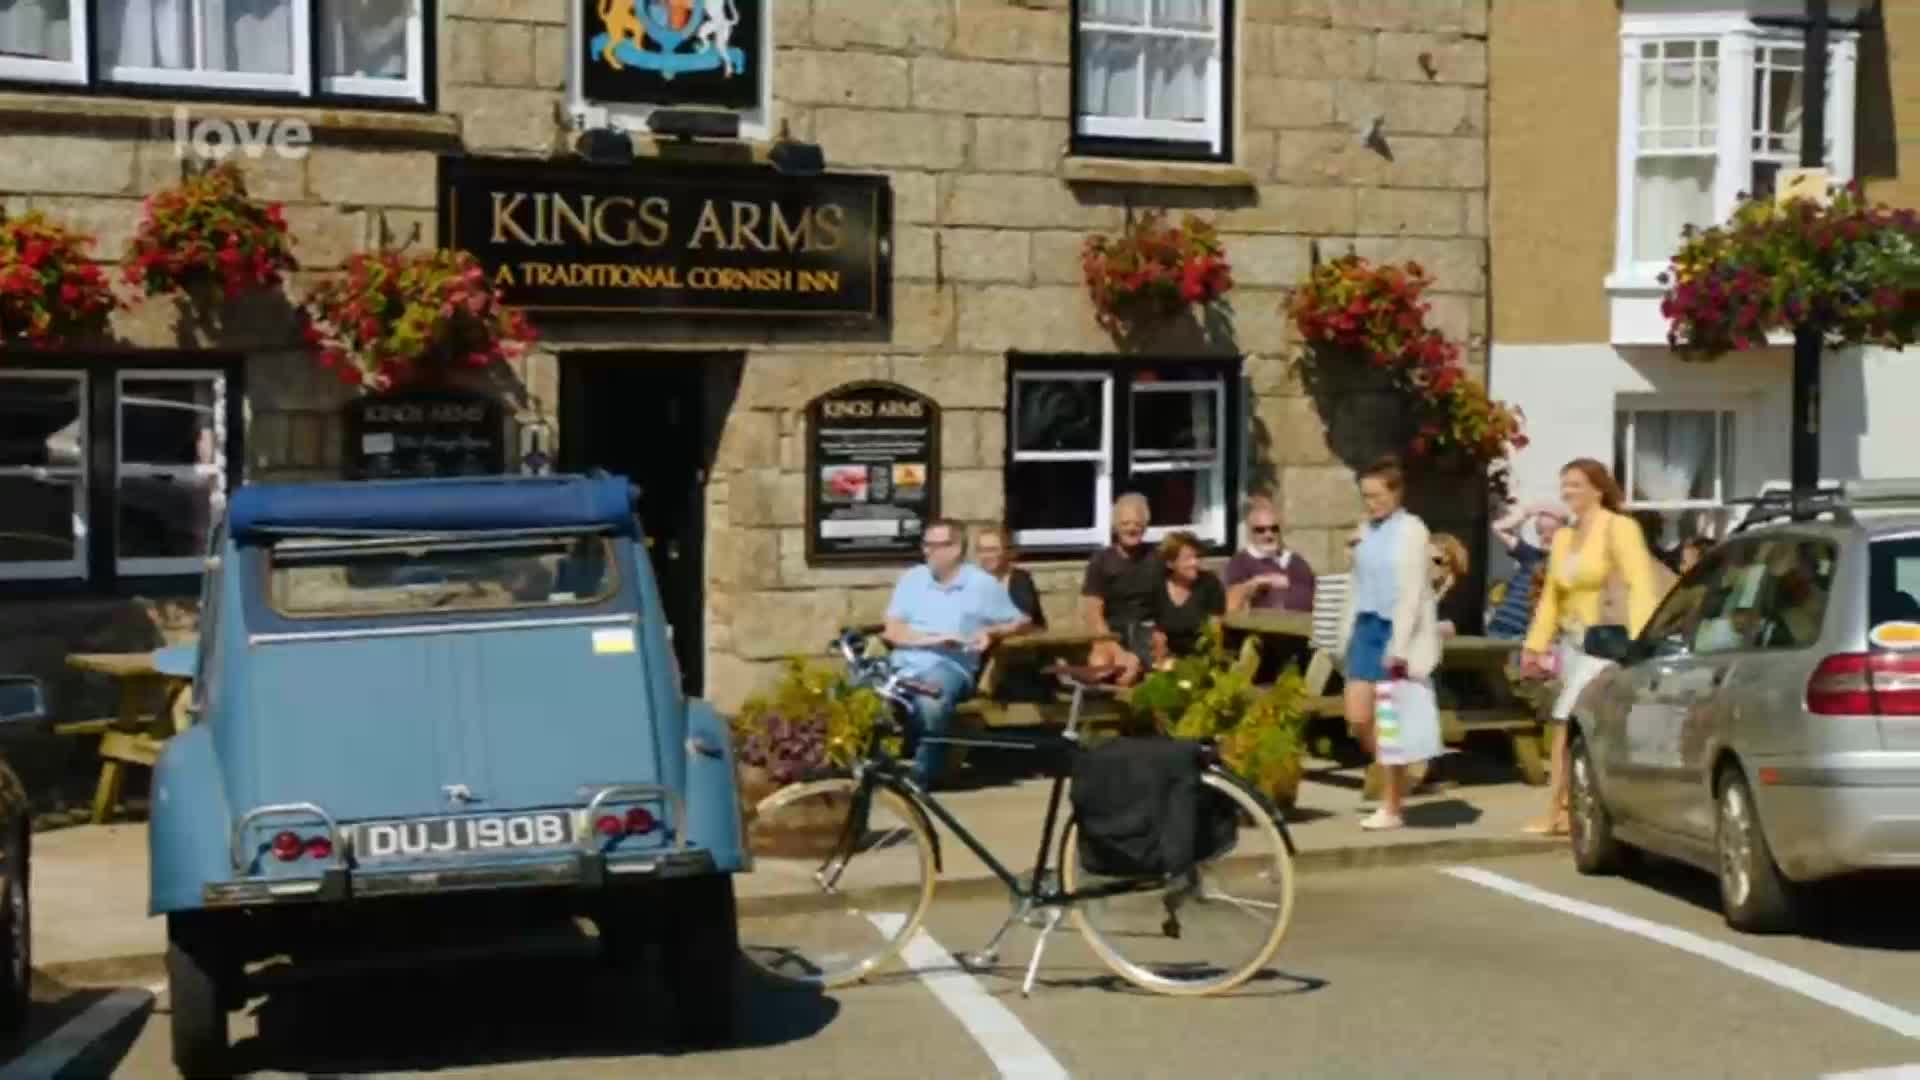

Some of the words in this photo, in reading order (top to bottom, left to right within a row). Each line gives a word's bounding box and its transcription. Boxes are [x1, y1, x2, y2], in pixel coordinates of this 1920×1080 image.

[490, 192, 669, 246] KINGS
[688, 199, 844, 253] ARMS
[496, 266, 515, 286] A
[521, 262, 683, 289] TRADITIONAL
[688, 266, 791, 291] CORNISH
[797, 270, 840, 292] INN
[368, 821, 457, 856] DUJ
